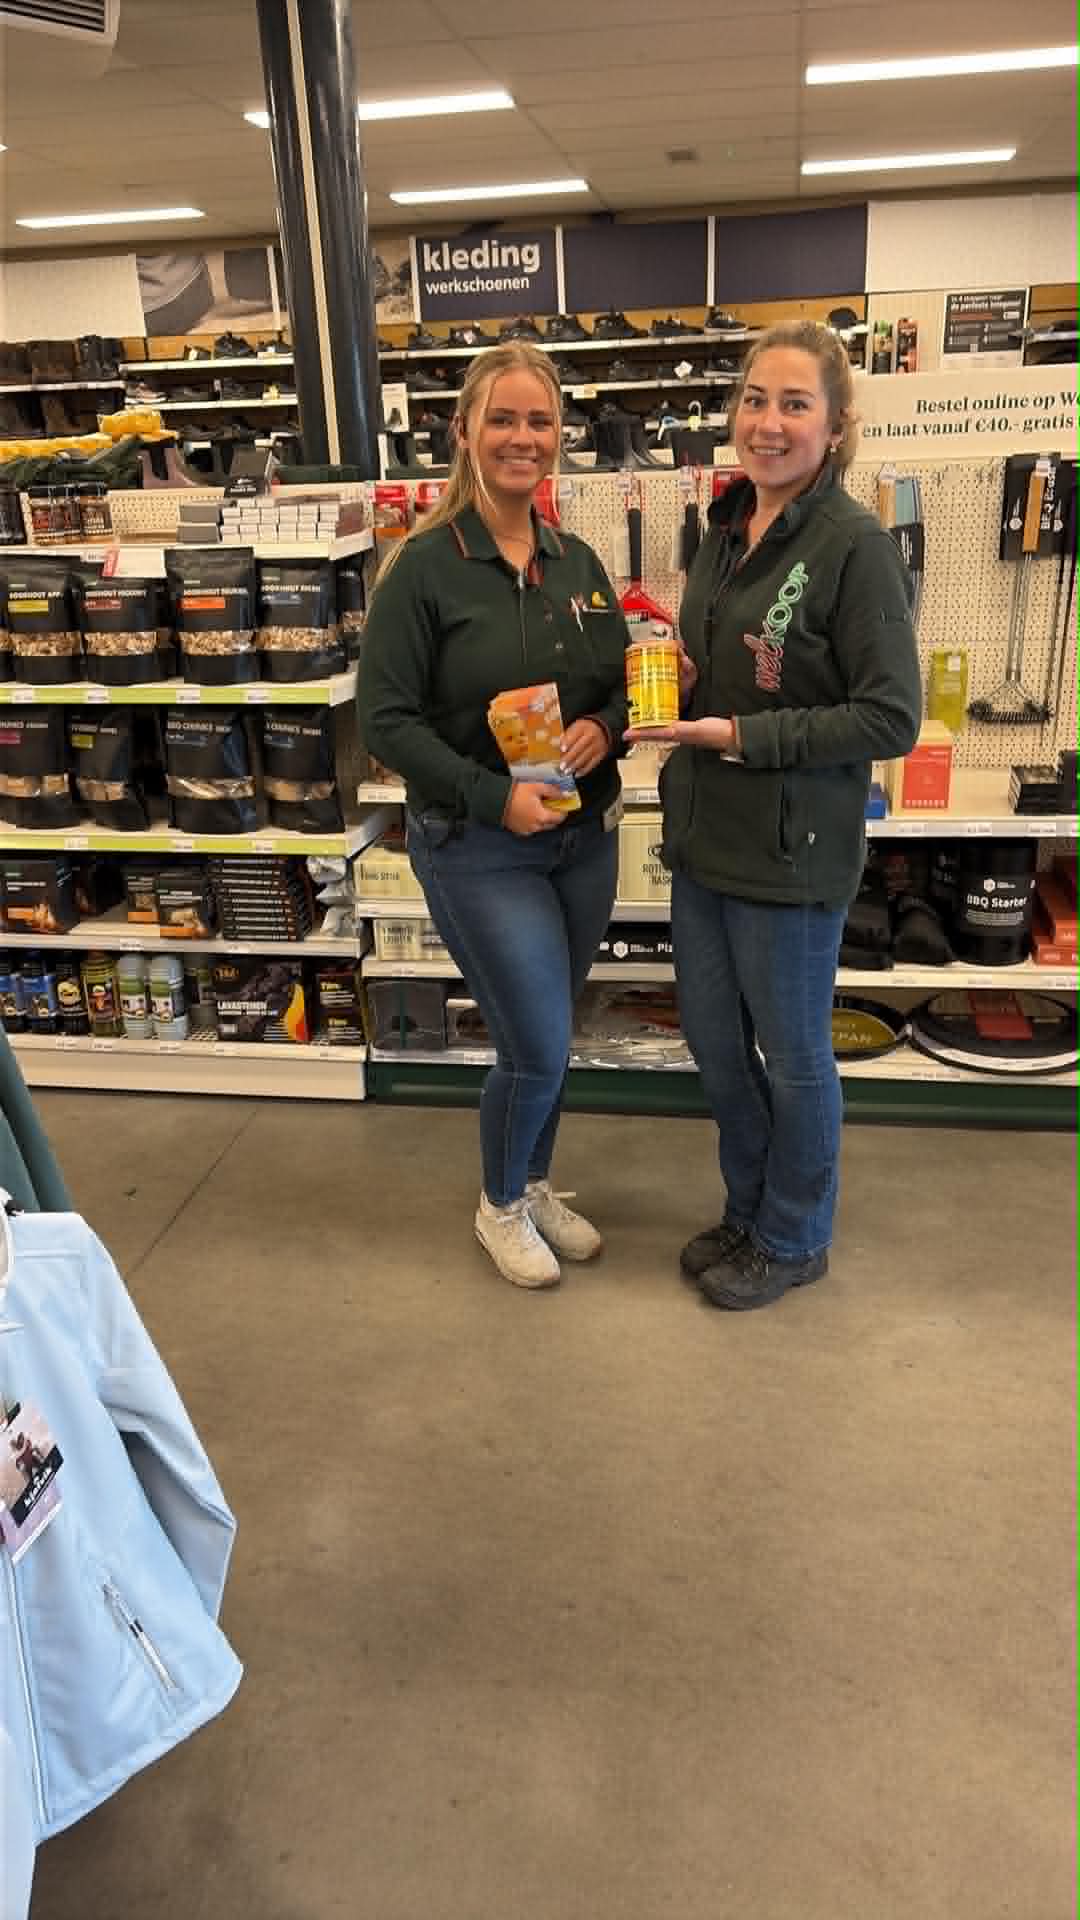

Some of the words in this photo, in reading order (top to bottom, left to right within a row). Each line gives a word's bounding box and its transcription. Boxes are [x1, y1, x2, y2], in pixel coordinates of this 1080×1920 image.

[423, 240, 540, 272] kleding
[425, 275, 529, 295] werkschoenen
[916, 396, 968, 414] Bestel
[972, 393, 1028, 410] online
[1032, 393, 1056, 410] op
[863, 425, 882, 438] en
[886, 423, 919, 437] laat
[920, 419, 970, 436] vanaf
[1022, 412, 1073, 433] gratis
[967, 894, 989, 909] BBQ
[991, 896, 1028, 909] Starter
